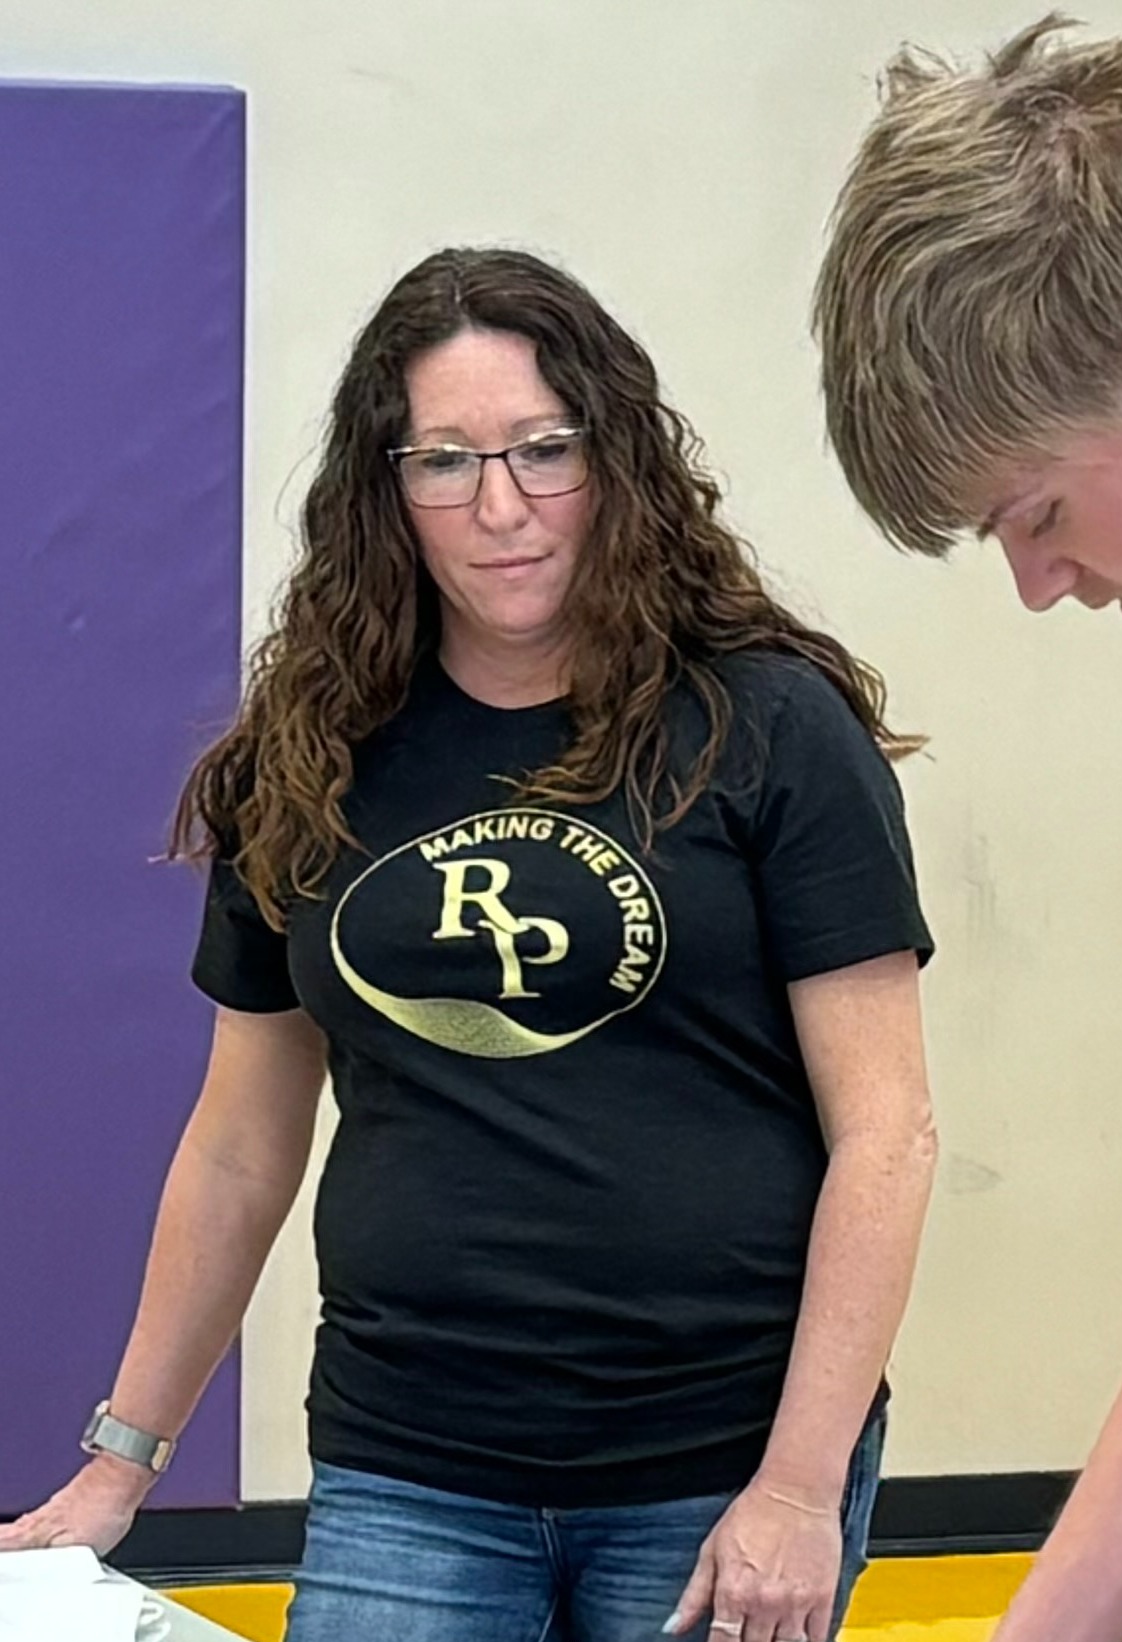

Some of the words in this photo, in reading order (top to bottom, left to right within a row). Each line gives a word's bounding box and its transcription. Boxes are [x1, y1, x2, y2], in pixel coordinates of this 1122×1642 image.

[419, 815, 554, 862] MAKING
[559, 825, 620, 877] THE
[607, 874, 654, 994] DREAM
